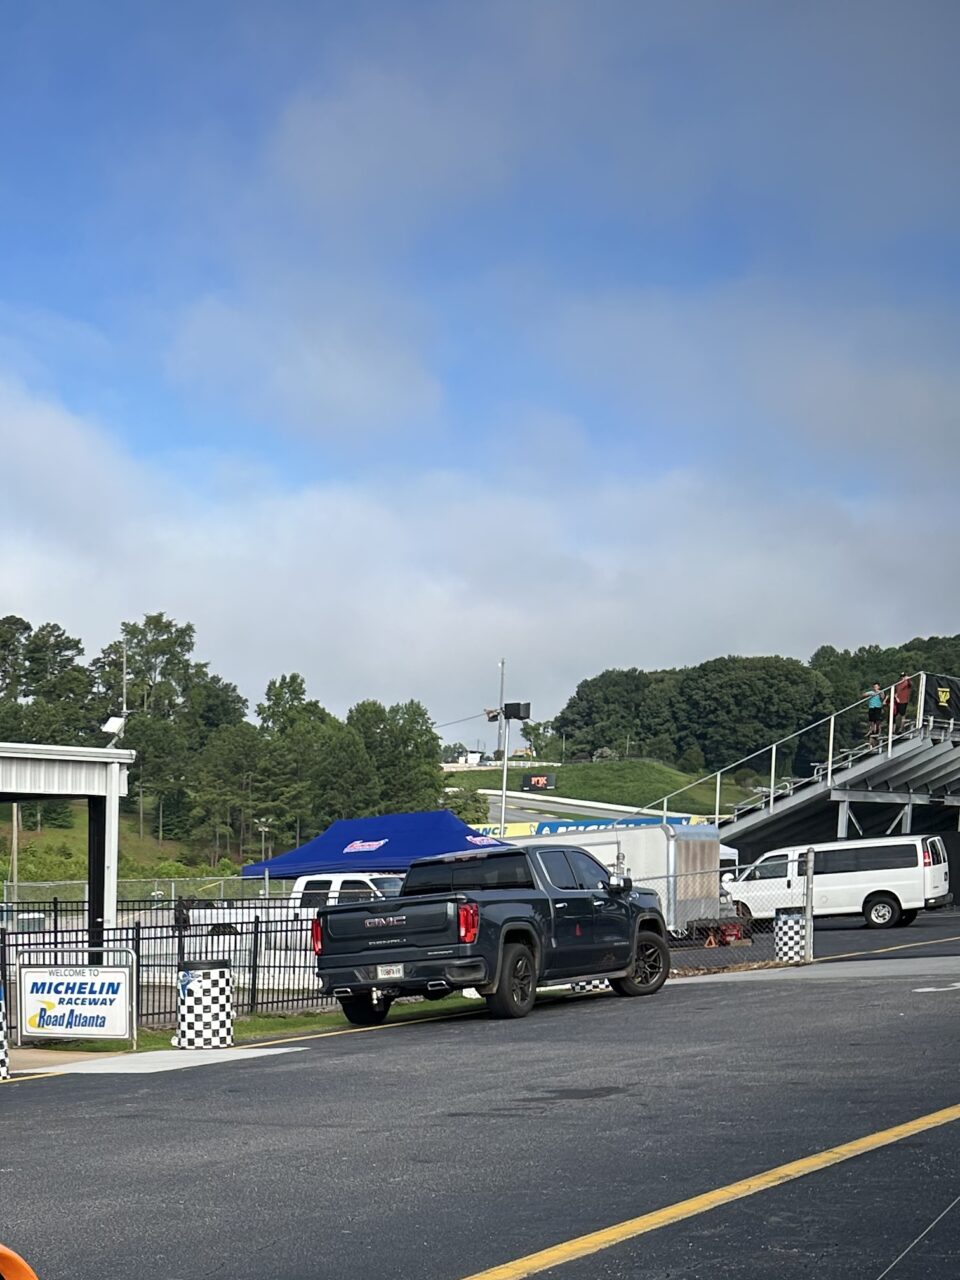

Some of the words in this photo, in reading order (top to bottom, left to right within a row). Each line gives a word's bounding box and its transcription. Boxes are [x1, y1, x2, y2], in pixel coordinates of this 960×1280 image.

[364, 915, 407, 928] GMC
[48, 969, 87, 977] WELCOME
[89, 968, 100, 977] TO
[30, 981, 121, 995] MICHELIN
[58, 997, 116, 1006] RACEWAY
[37, 1007, 66, 1029] Road
[65, 1008, 107, 1029] Atlanta
